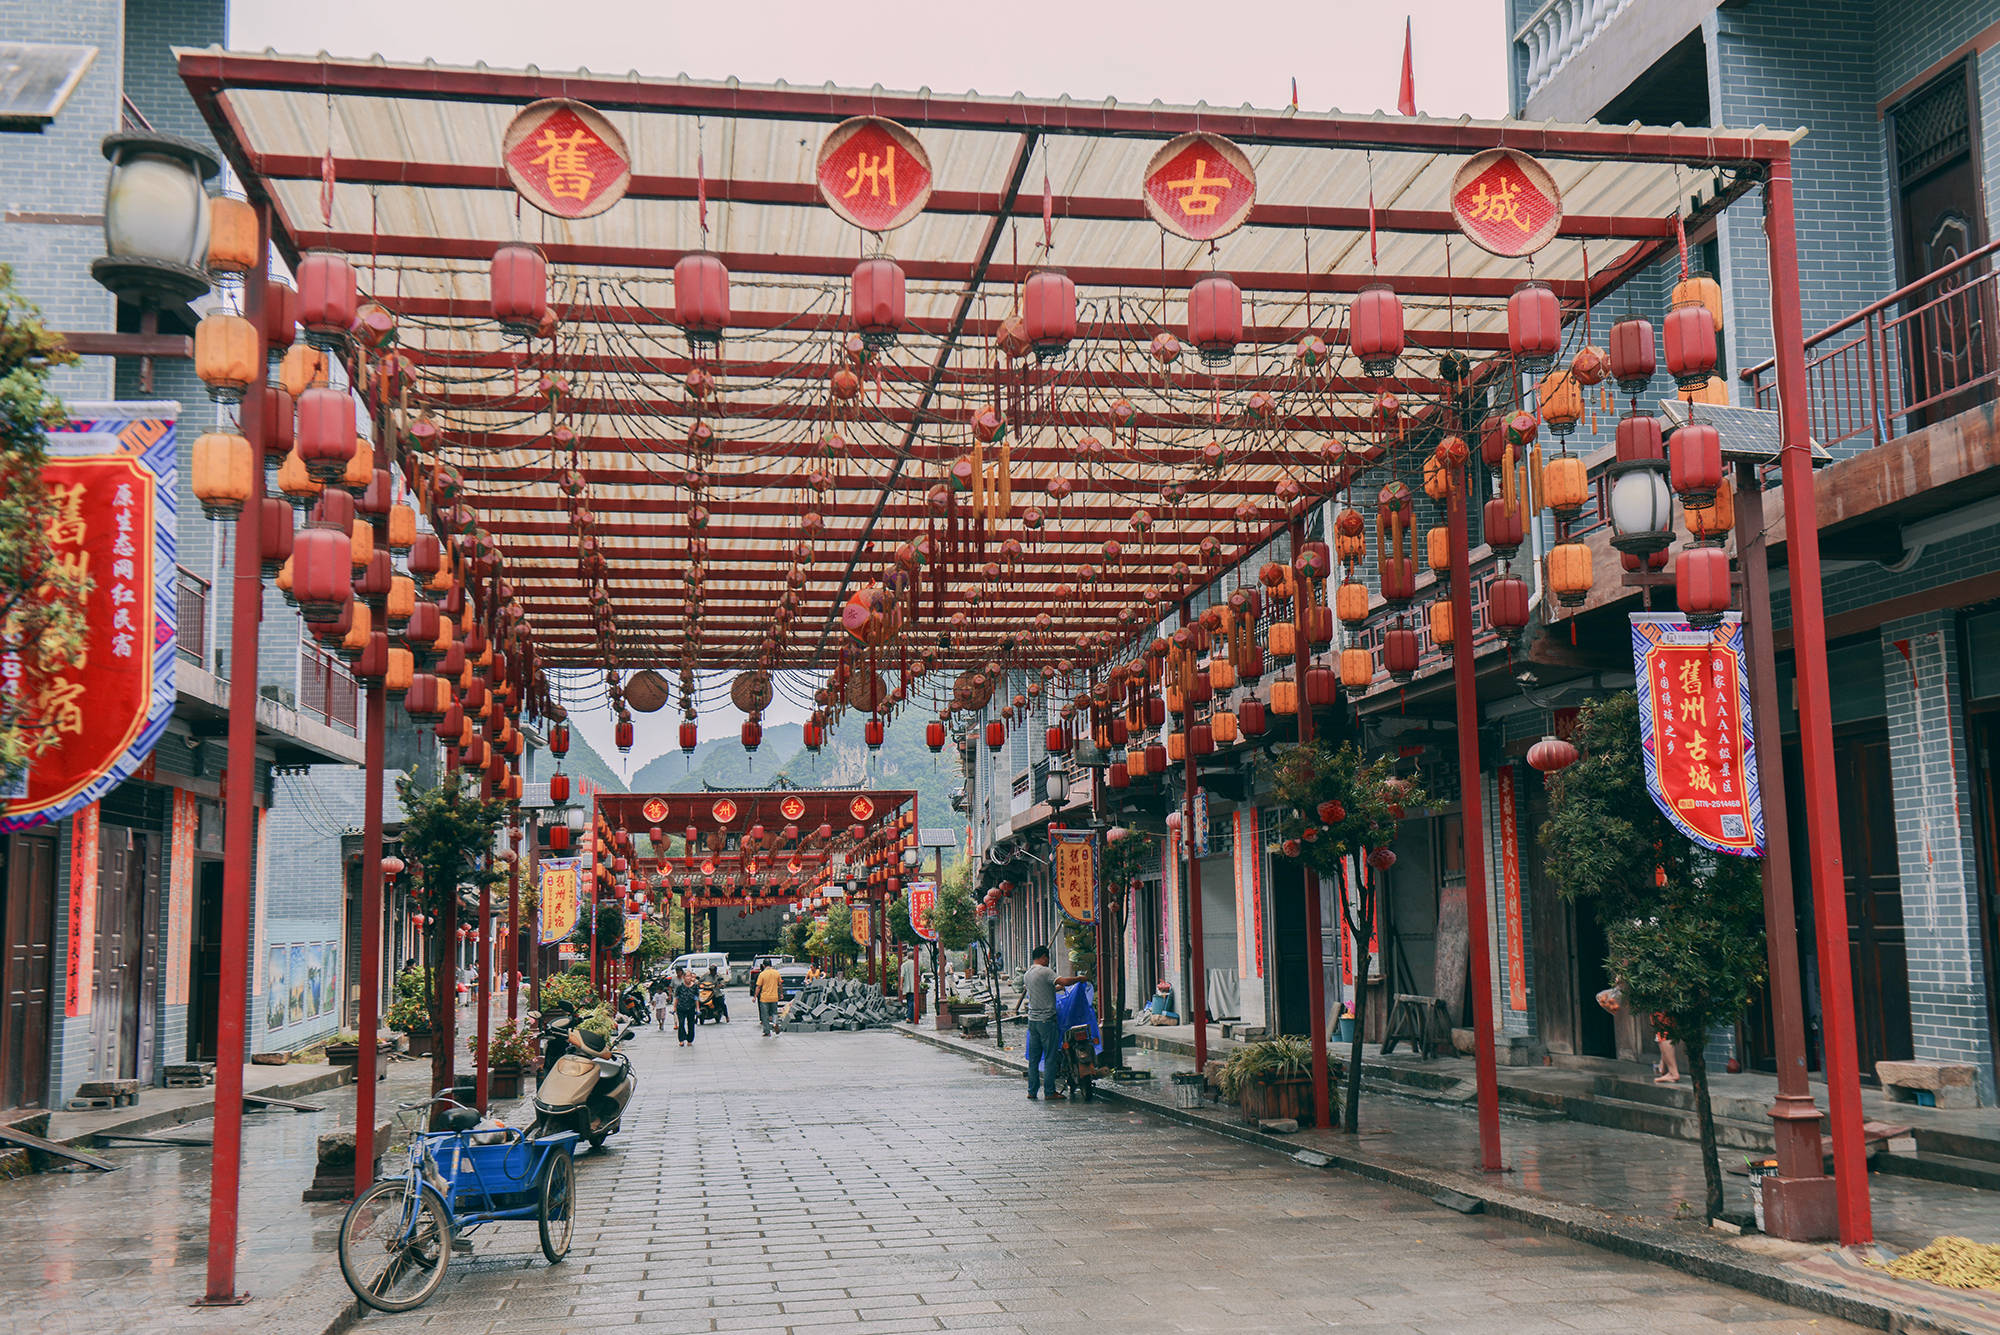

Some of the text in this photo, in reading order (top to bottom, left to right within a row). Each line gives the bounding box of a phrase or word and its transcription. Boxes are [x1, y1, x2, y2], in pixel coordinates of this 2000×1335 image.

[843, 145, 898, 207] 州
[1167, 159, 1233, 217] 古
[1469, 177, 1532, 233] 城
[111, 483, 137, 657] 原生态网红民宿
[1658, 658, 1677, 756] 中国绣球之乡
[1678, 658, 1718, 796] 舊州古城
[1712, 658, 1734, 793] 国家AAAA级景区
[719, 804, 731, 818] 州
[785, 801, 799, 815] 古
[854, 801, 868, 814] 城
